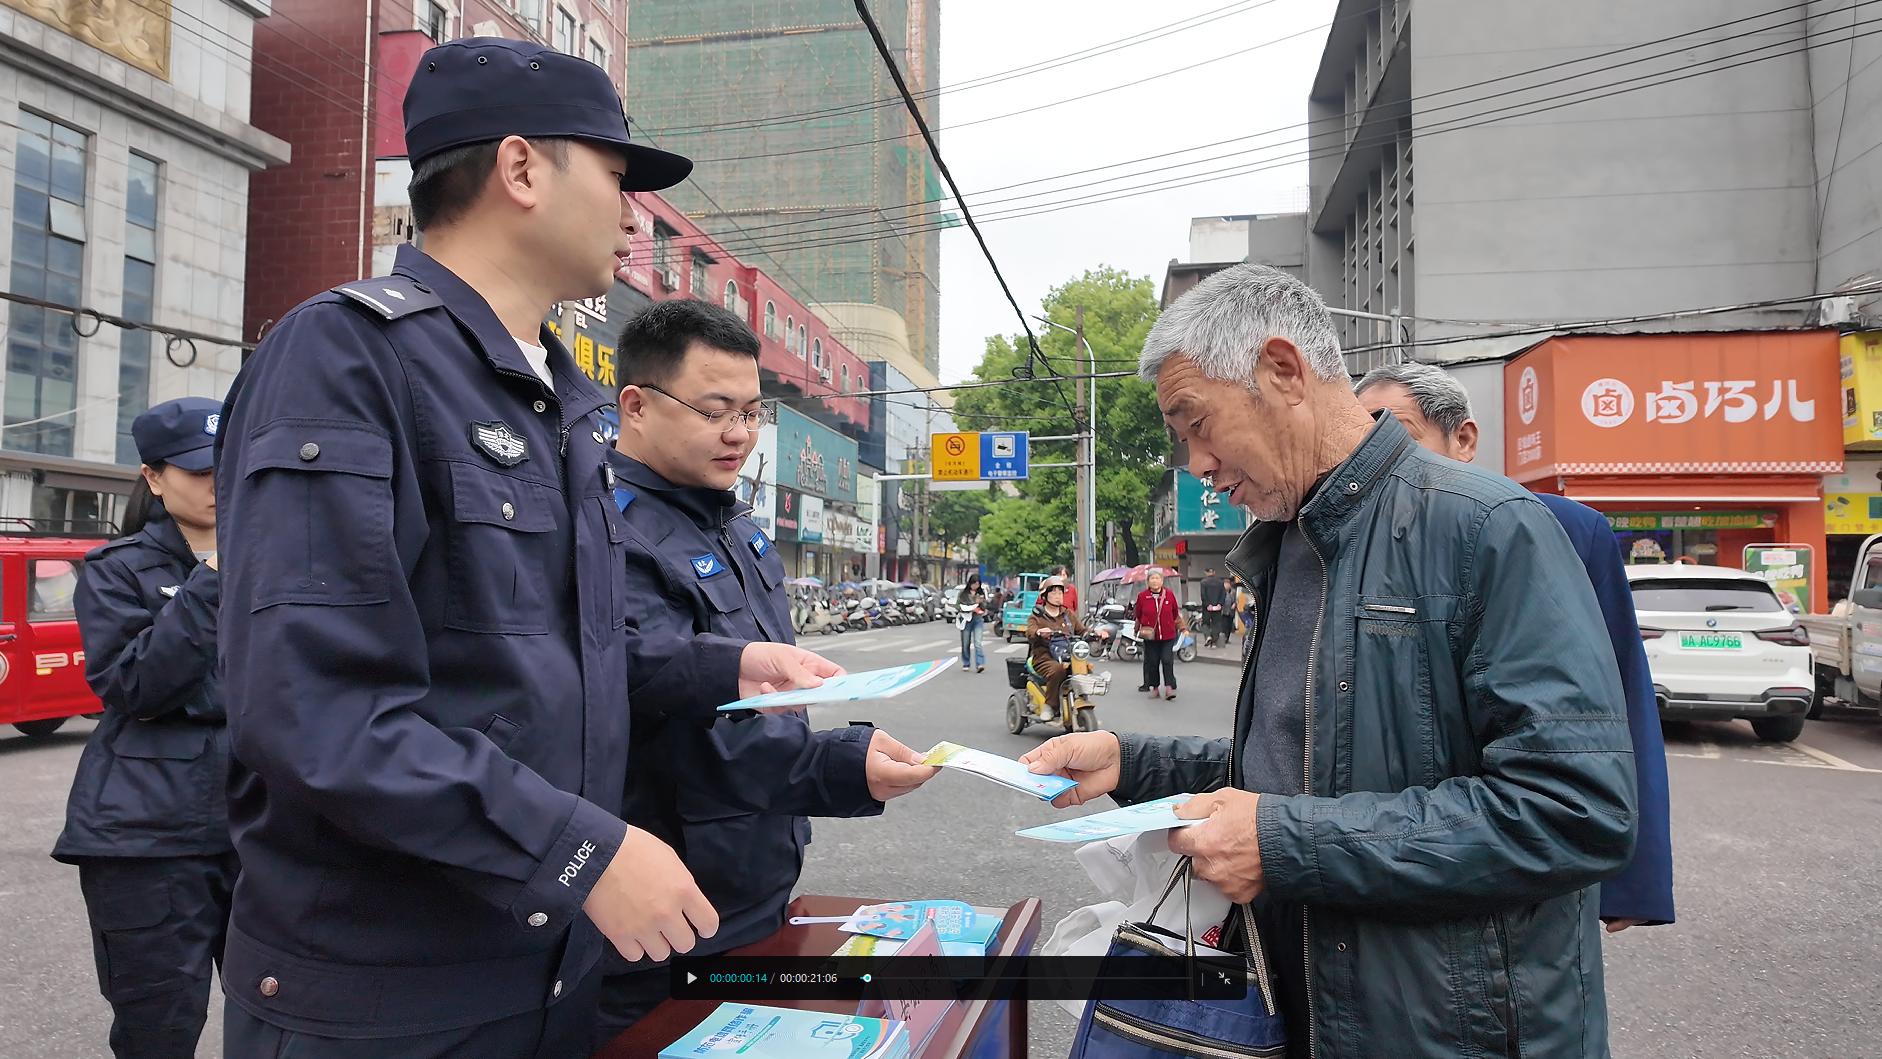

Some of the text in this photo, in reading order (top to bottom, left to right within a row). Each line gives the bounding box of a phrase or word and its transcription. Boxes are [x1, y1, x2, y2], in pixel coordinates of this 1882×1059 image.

[1646, 379, 1815, 424] 卤巧儿
[558, 839, 596, 887] POLICE
